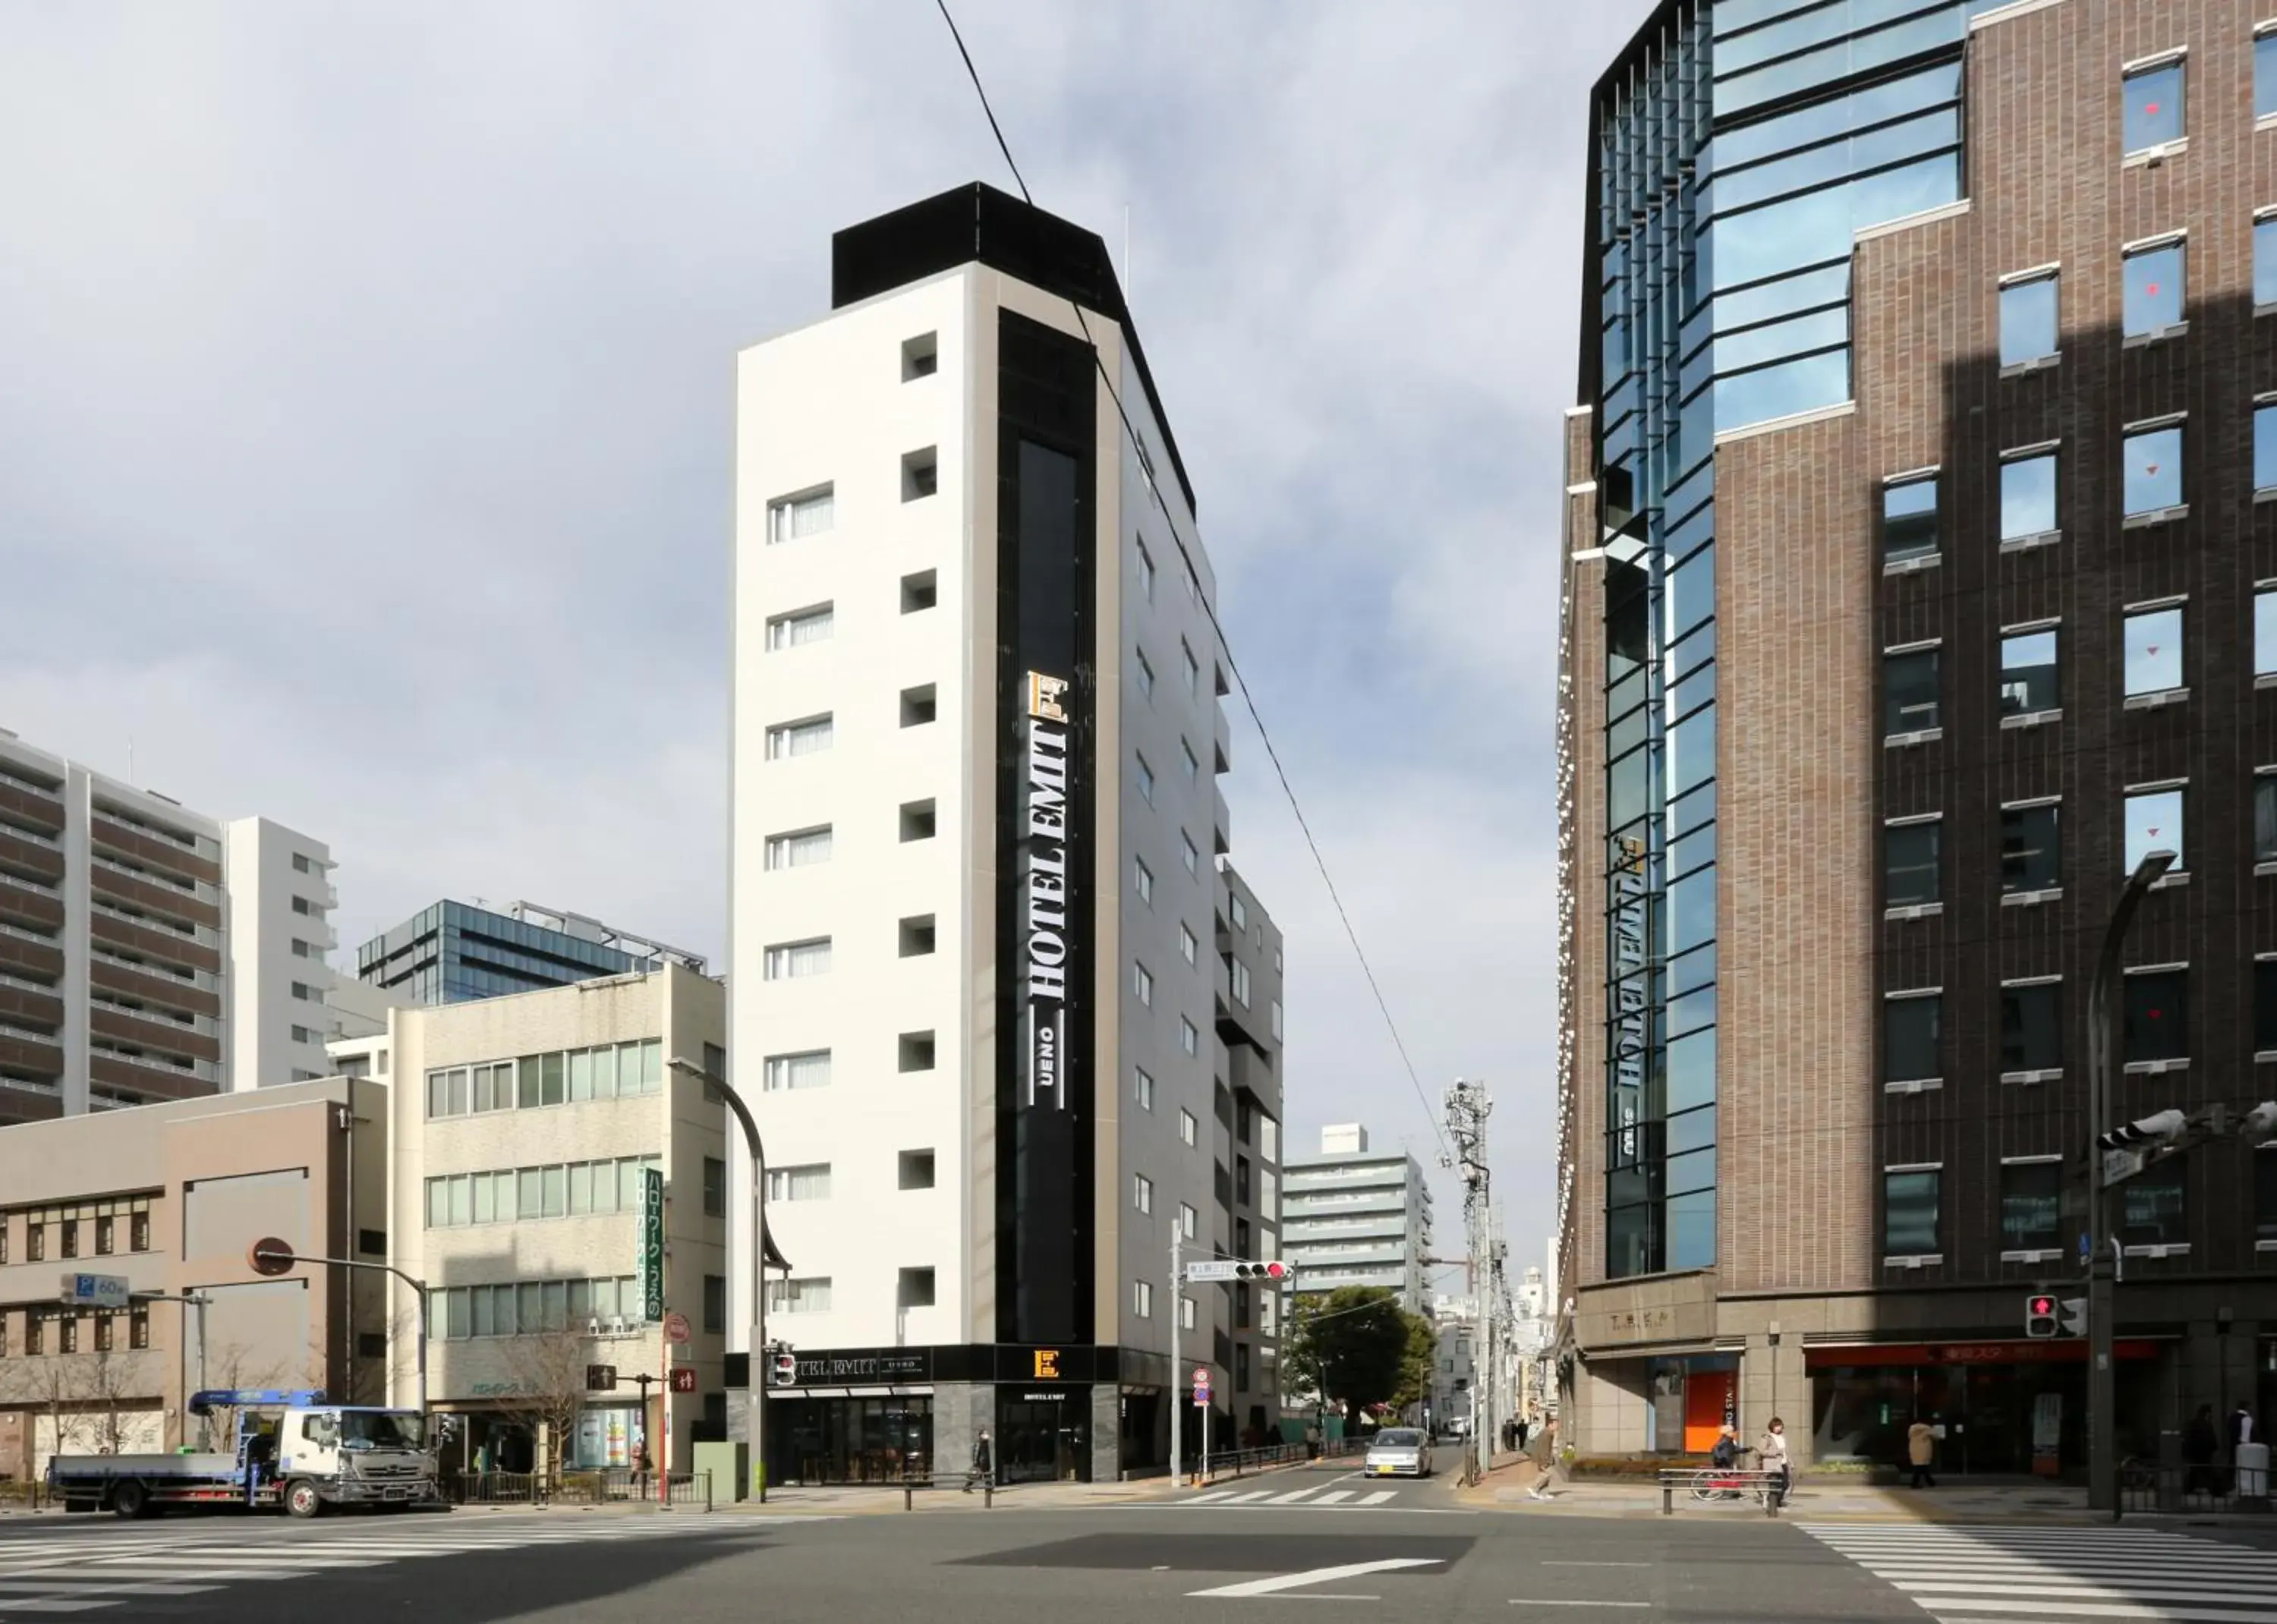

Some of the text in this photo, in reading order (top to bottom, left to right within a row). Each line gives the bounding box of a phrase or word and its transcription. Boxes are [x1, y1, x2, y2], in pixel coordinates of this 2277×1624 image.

[1028, 719, 1066, 1002] HOTEL EMIT
[1039, 1027, 1054, 1086] UENO
[648, 1174, 660, 1258] ハローワーク
